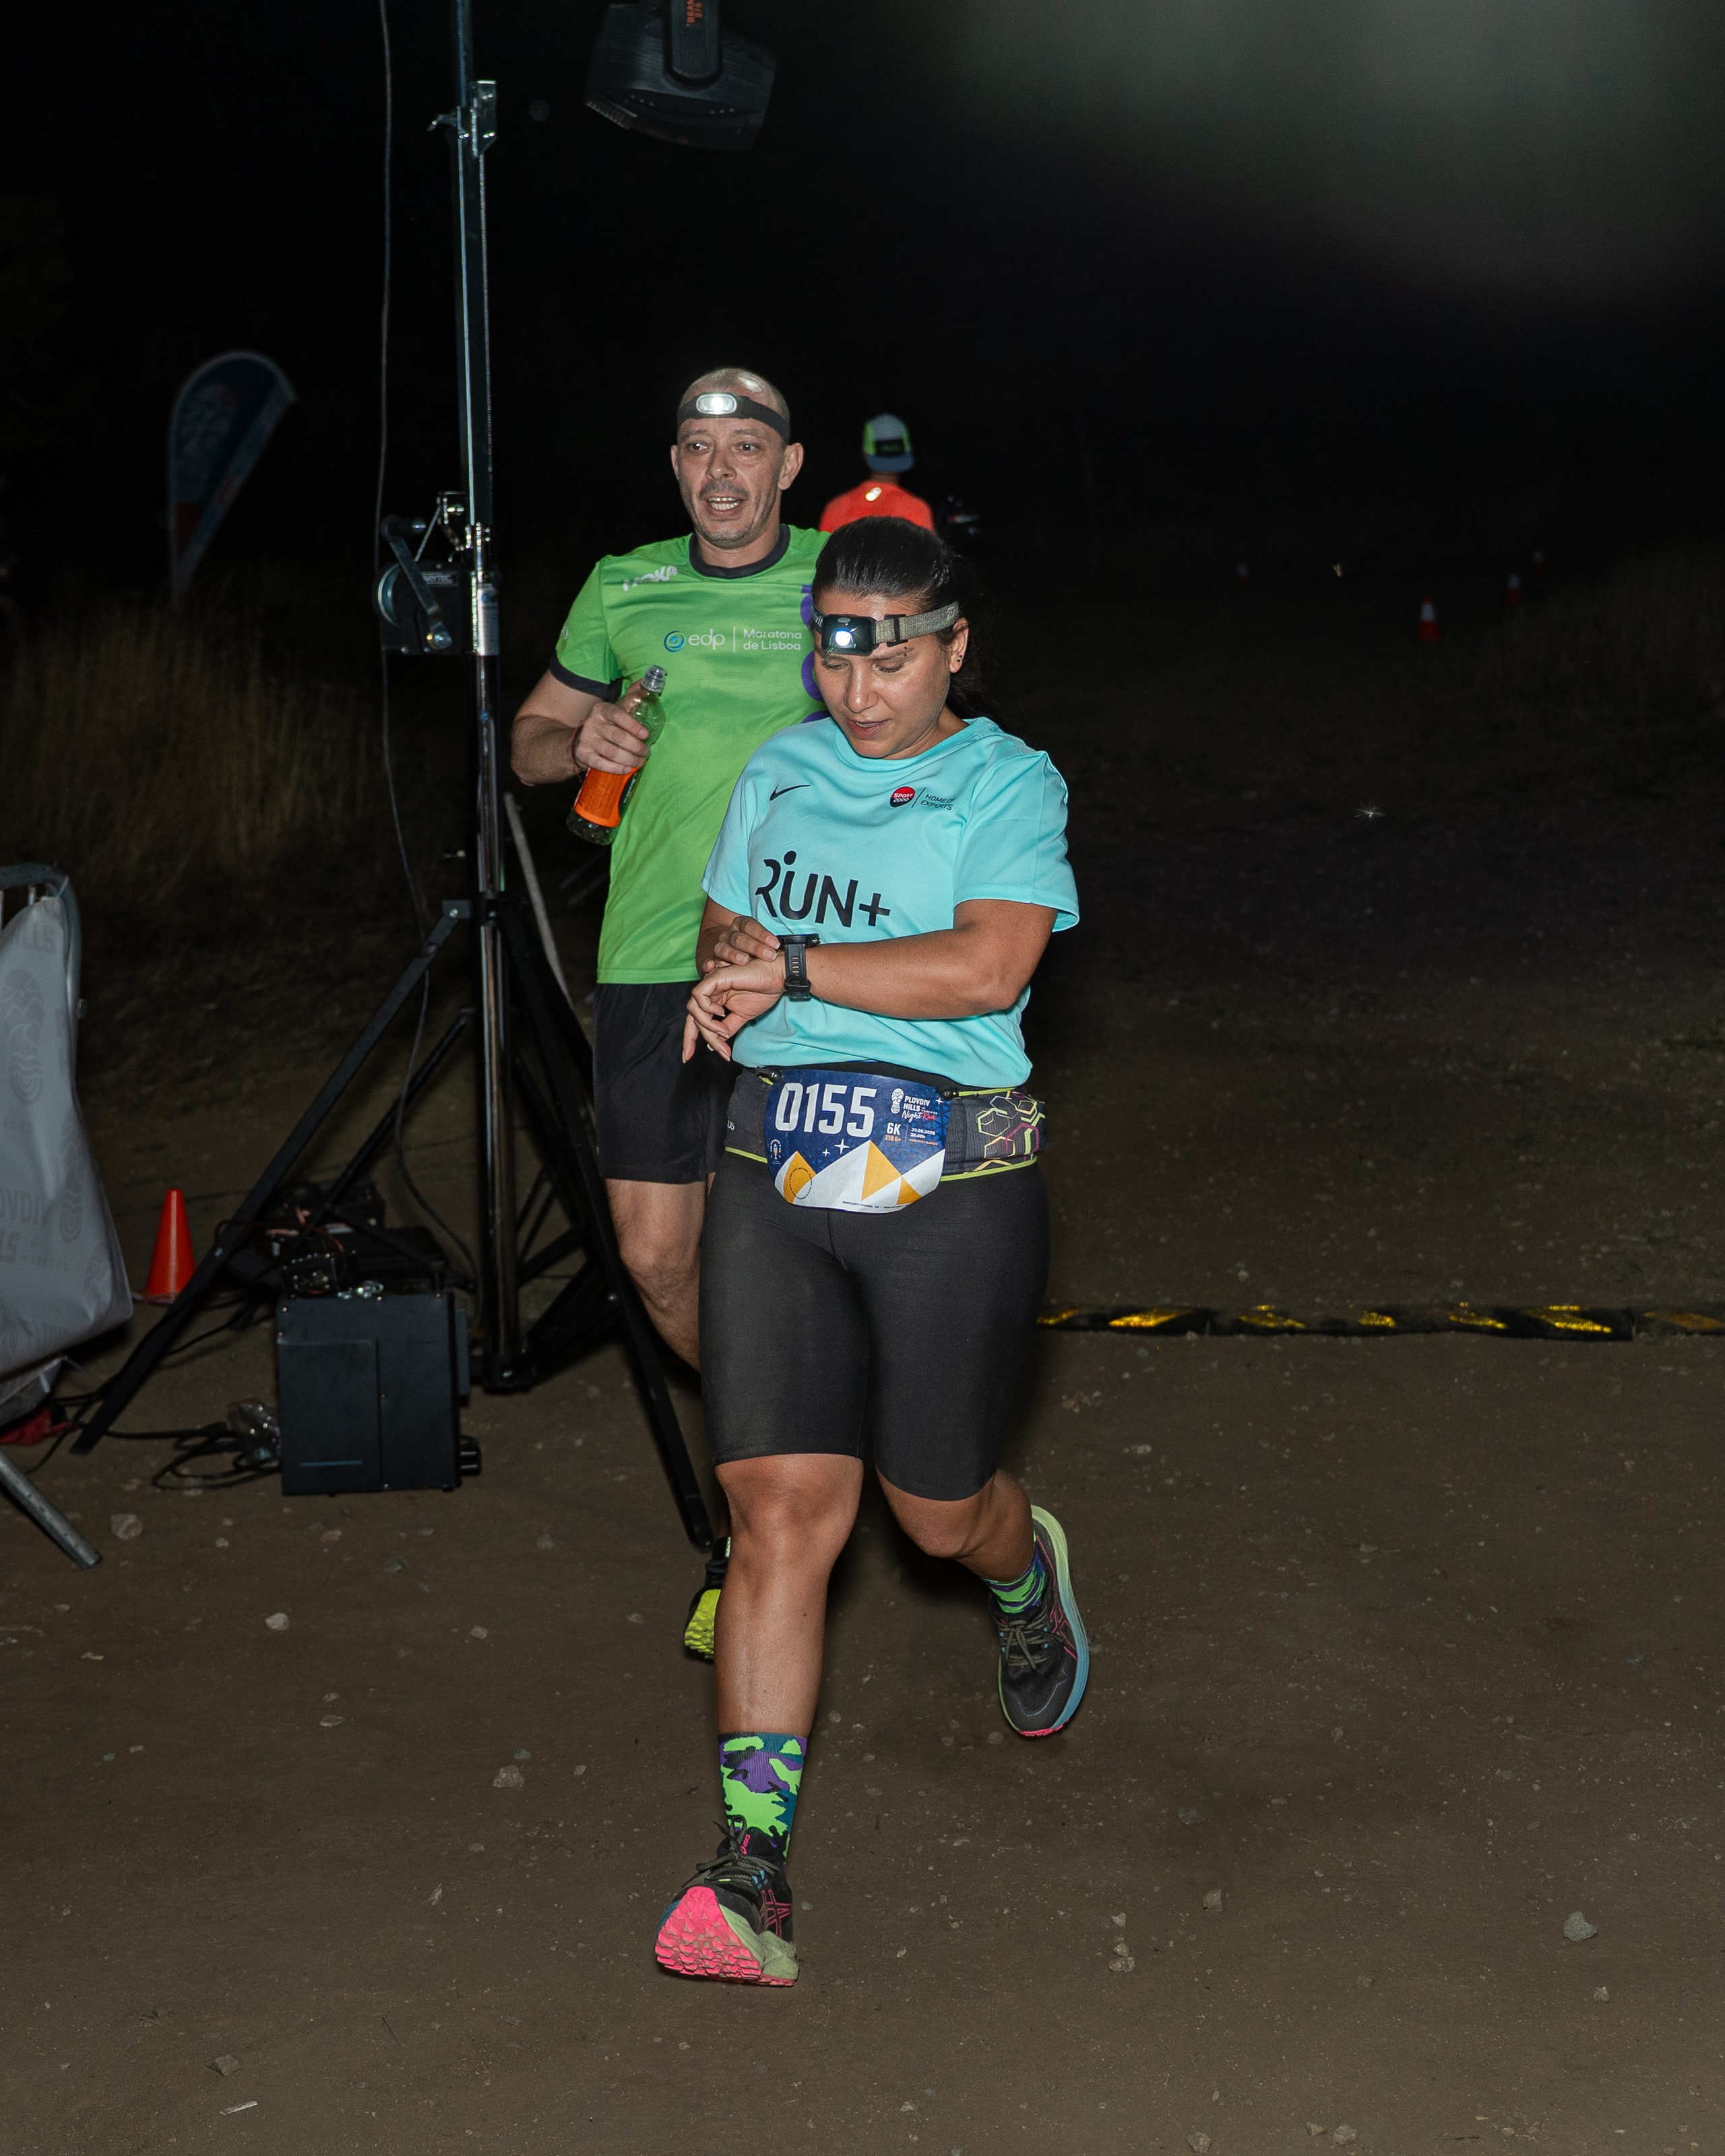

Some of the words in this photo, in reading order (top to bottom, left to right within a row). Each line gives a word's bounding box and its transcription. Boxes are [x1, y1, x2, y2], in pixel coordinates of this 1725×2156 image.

[688, 629, 725, 649] edp
[743, 628, 802, 639] Maratona
[743, 640, 758, 650] de
[761, 640, 801, 650] Lisboa
[925, 794, 947, 803] HOME
[920, 800, 953, 811] EXPERTS
[904, 1096, 931, 1106] PLOVDIV
[775, 1082, 877, 1138] 0155
[903, 1103, 920, 1112] HILLS
[902, 1110, 922, 1122] Night
[887, 1122, 902, 1135] 6K
